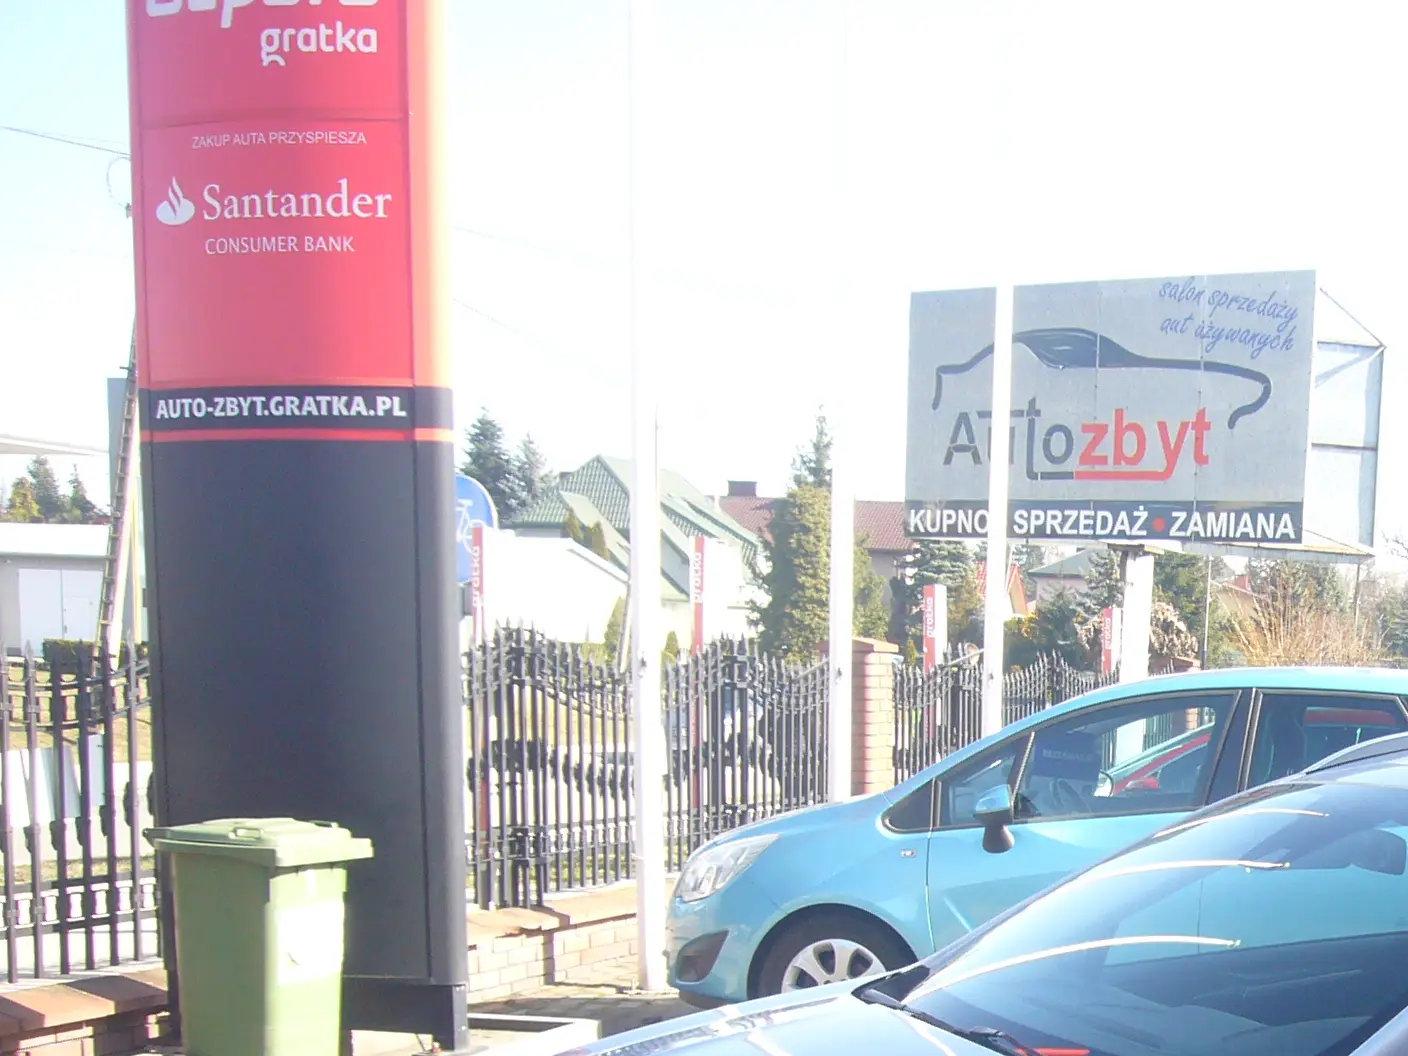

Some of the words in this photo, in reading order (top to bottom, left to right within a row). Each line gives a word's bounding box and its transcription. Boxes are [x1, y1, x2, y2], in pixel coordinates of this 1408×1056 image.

[260, 21, 378, 67] gratka
[192, 134, 231, 149] ZAKUP
[234, 132, 266, 146] AUTA
[269, 131, 368, 145] PRZYSPIESZA
[202, 177, 393, 221] Santander
[205, 236, 299, 255] CONSUMER
[304, 235, 355, 253] BANK
[1159, 276, 1205, 306] salon
[1207, 290, 1298, 333] sprzedaży
[1160, 312, 1195, 336] aut
[156, 395, 408, 420] AUTO-ZBYT.GRATKA.PL
[909, 508, 989, 534] KUPNO
[1013, 505, 1148, 537] SPRZEDAŻ
[1168, 511, 1296, 540] ZAMIANA
